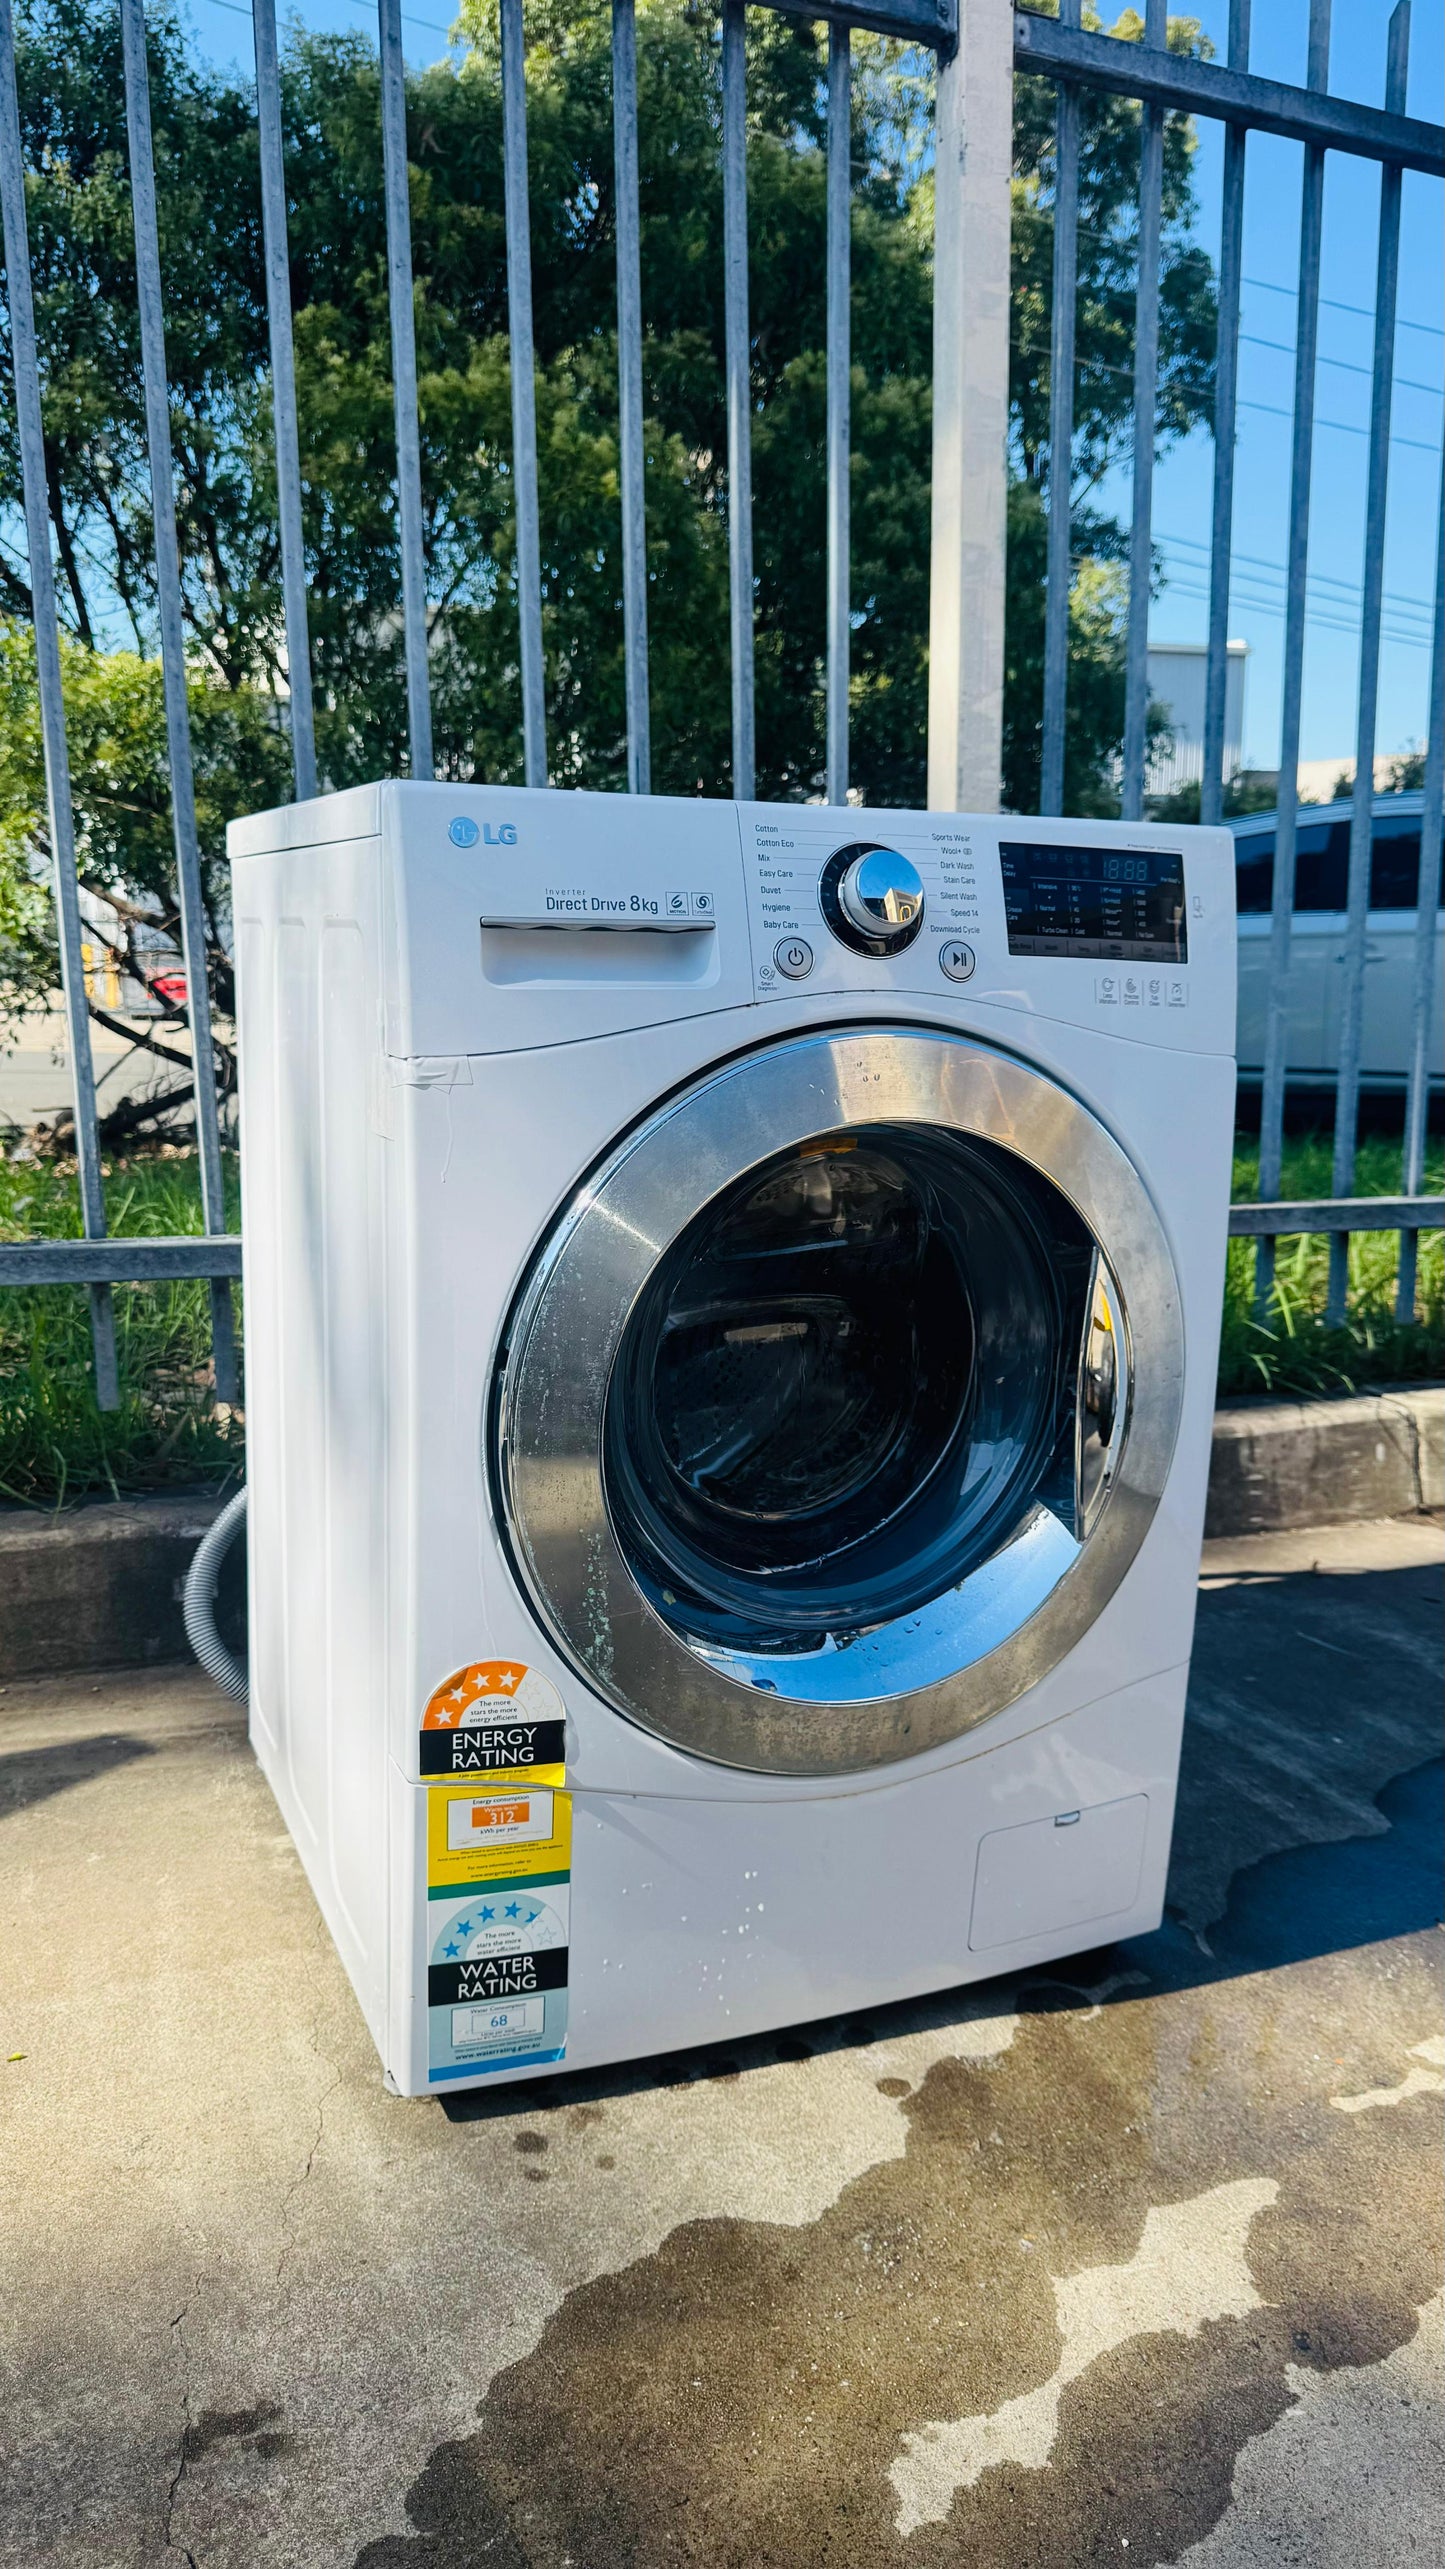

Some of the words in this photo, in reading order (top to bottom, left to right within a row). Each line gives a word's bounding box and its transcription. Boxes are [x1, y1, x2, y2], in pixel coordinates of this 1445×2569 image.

[755, 824, 778, 832] Cotton
[483, 823, 518, 845] LG
[932, 833, 952, 842] Sports
[954, 834, 970, 842] Wear
[756, 838, 780, 847] Cotton
[781, 839, 794, 848] Eco
[758, 854, 770, 862] Mix
[940, 861, 956, 869] Dark
[956, 862, 974, 870] Wash
[760, 869, 776, 878] Easy
[777, 869, 793, 878] Care
[944, 876, 960, 884] Stain
[960, 876, 976, 884] Care
[545, 888, 586, 896] Inverter
[760, 886, 782, 894] Duvet
[940, 892, 959, 900] Silent
[960, 892, 978, 900] Wash
[546, 897, 588, 912] Direct
[591, 897, 626, 912] Drive
[762, 904, 791, 912] Hygiene
[950, 908, 971, 917] Speed
[972, 909, 979, 917] 14
[764, 920, 782, 929] Baby
[782, 920, 799, 929] Care
[930, 924, 962, 933] Download
[962, 926, 980, 934] Cycle
[470, 1708, 486, 1716] stars
[469, 1716, 492, 1724] energy
[492, 1714, 518, 1722] efficient
[452, 1727, 538, 1750] ENERGY
[452, 1746, 534, 1769] RATING
[492, 1795, 530, 1803] consumption
[490, 1810, 515, 1825] 312
[496, 1945, 520, 1954] efficient
[460, 1956, 536, 1980] WATER
[458, 1974, 537, 1999] RATING
[490, 2014, 508, 2028] 68
